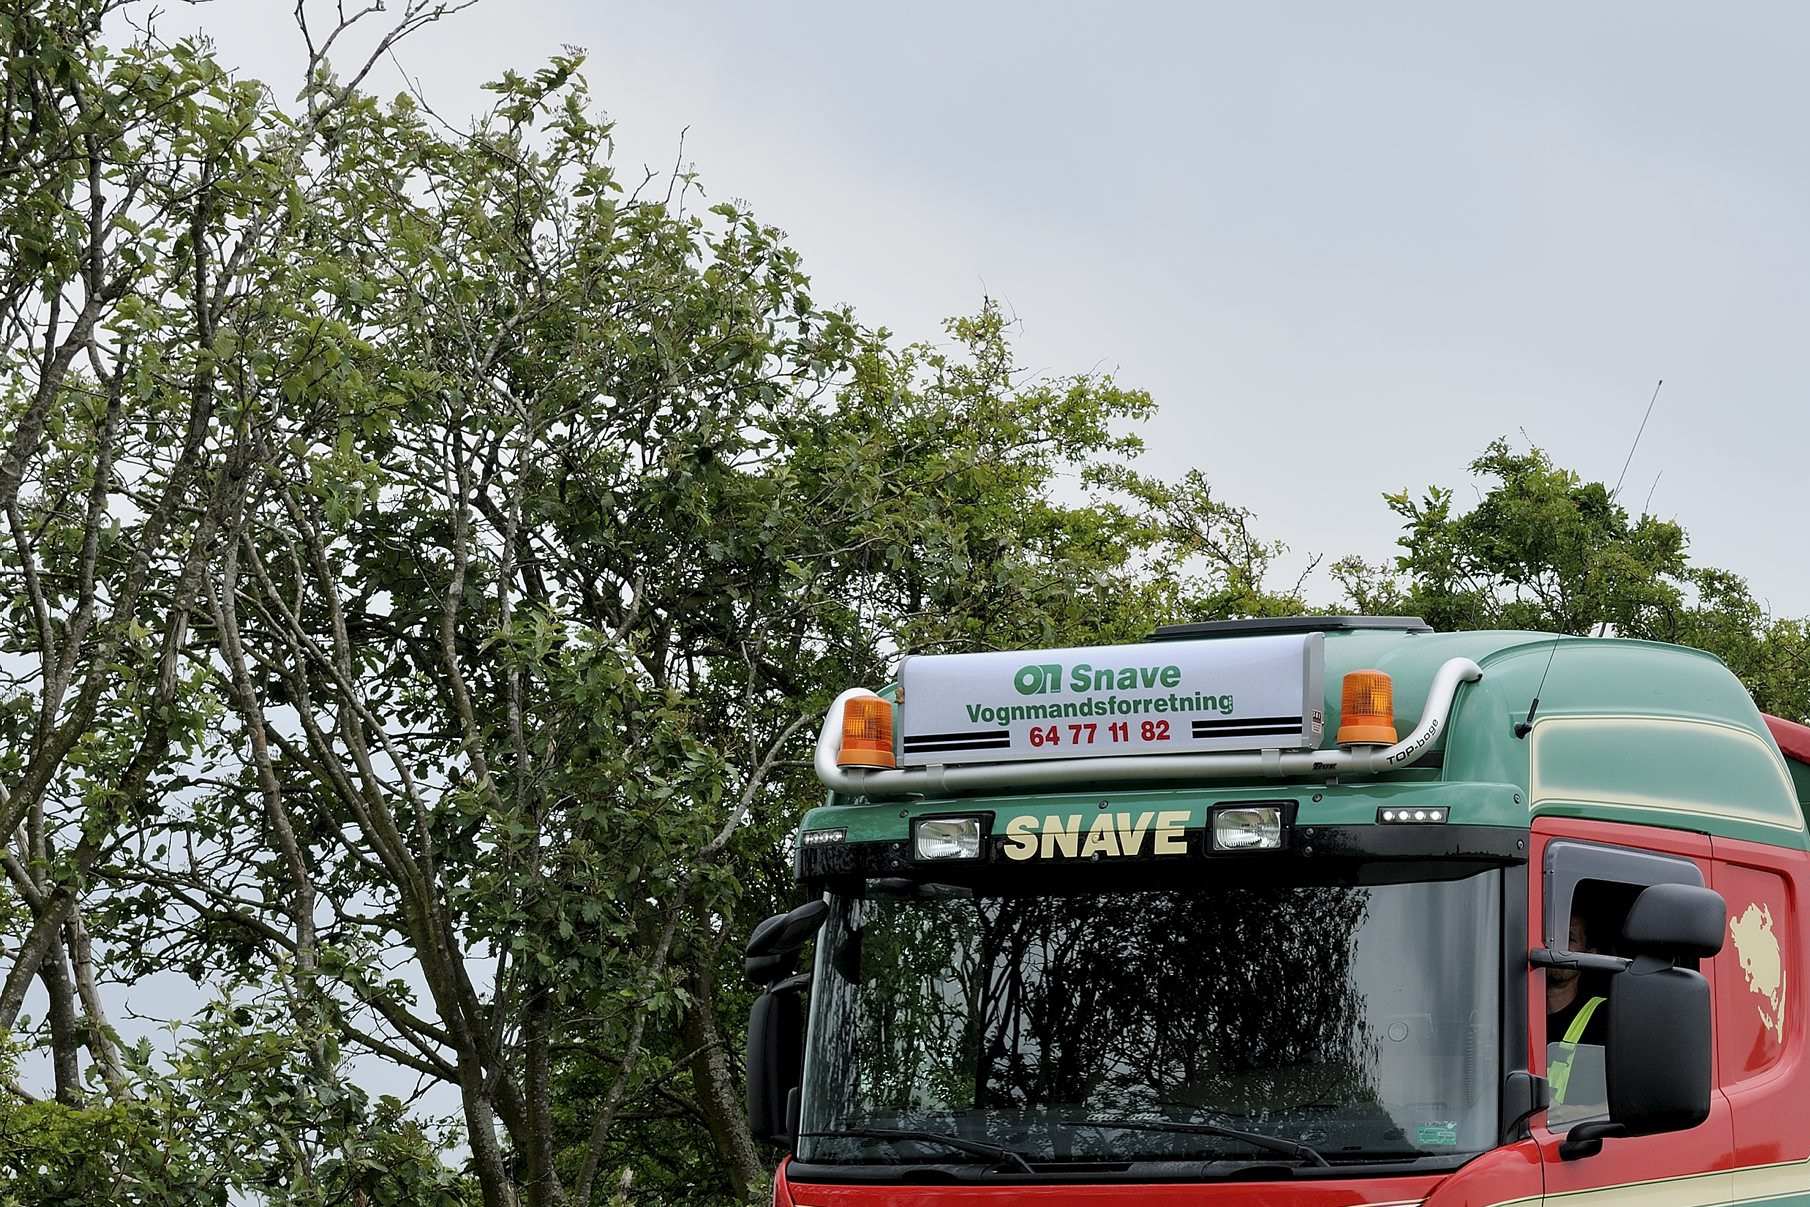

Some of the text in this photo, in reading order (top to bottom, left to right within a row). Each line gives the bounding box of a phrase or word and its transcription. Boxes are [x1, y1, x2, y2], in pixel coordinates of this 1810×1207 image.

[1069, 663, 1182, 693] Snave
[966, 691, 1234, 727] Vognmandsforretning
[1029, 720, 1171, 748] 64 77 11 82
[1003, 810, 1192, 861] SNAVE
